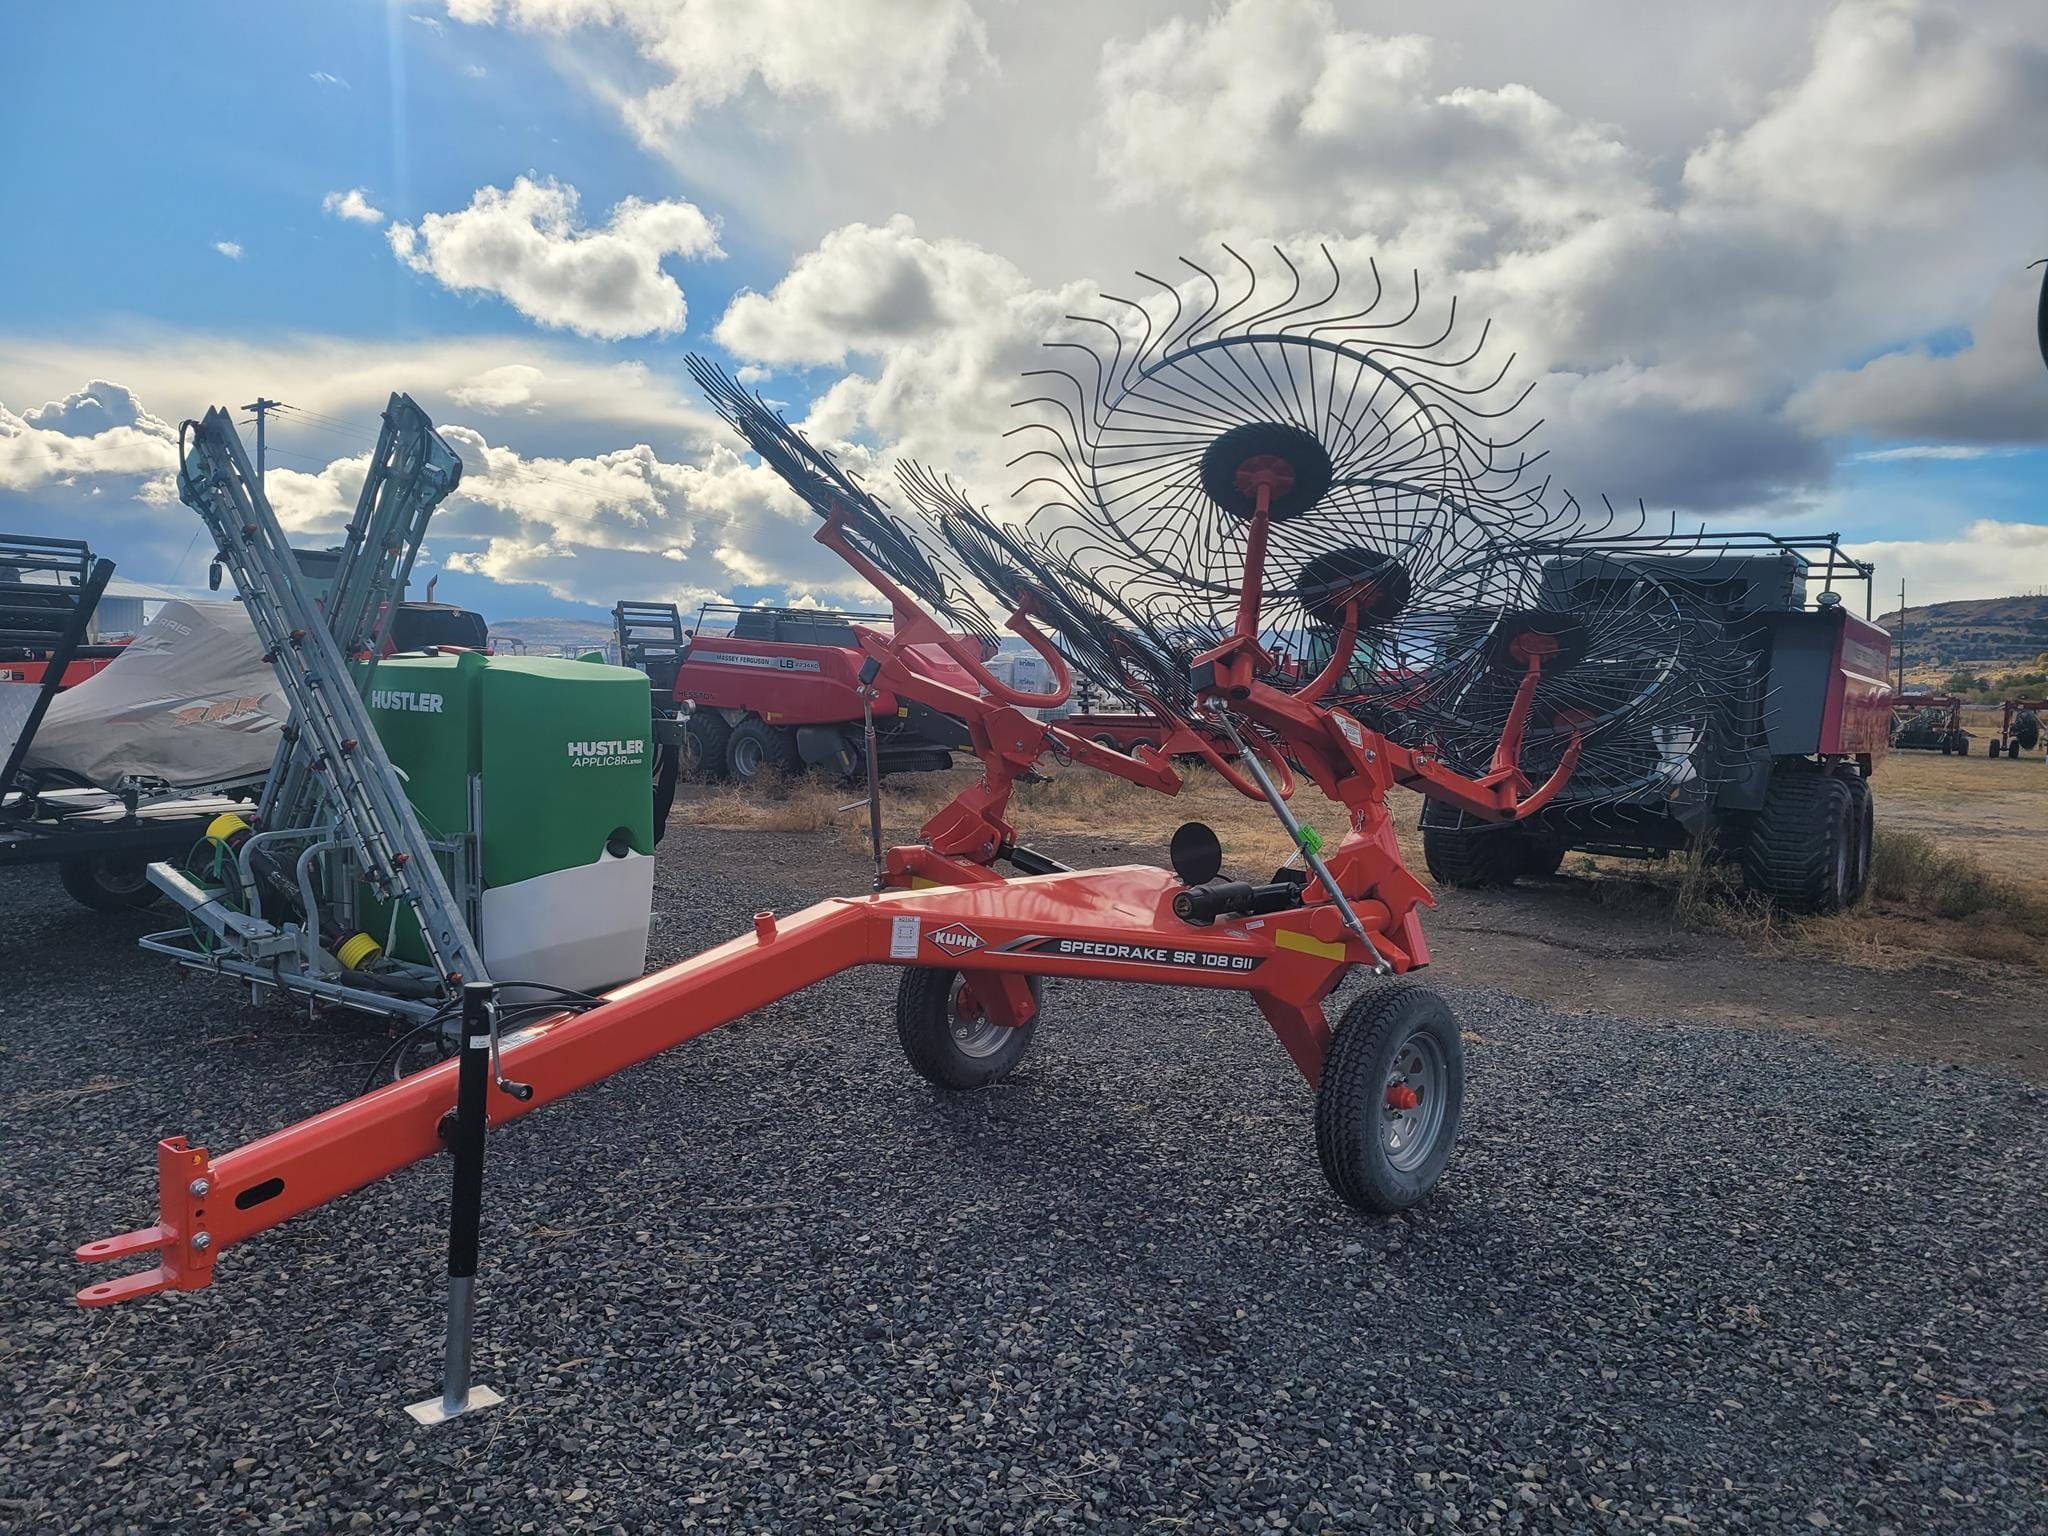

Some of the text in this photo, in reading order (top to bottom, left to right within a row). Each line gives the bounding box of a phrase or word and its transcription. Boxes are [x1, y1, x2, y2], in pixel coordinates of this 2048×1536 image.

[159, 617, 193, 636] ARIS
[716, 654, 738, 663] MASSEY
[740, 656, 770, 665] FERGUSON
[780, 659, 794, 669] LB
[371, 690, 443, 713] HUSTLER
[567, 739, 644, 757] HUSTLER
[571, 756, 628, 768] APPLIC8R
[935, 931, 978, 949] KUHN
[1059, 940, 1168, 962] SPEEDRAKE
[1173, 951, 1196, 965] SR
[1201, 954, 1228, 967] 108
